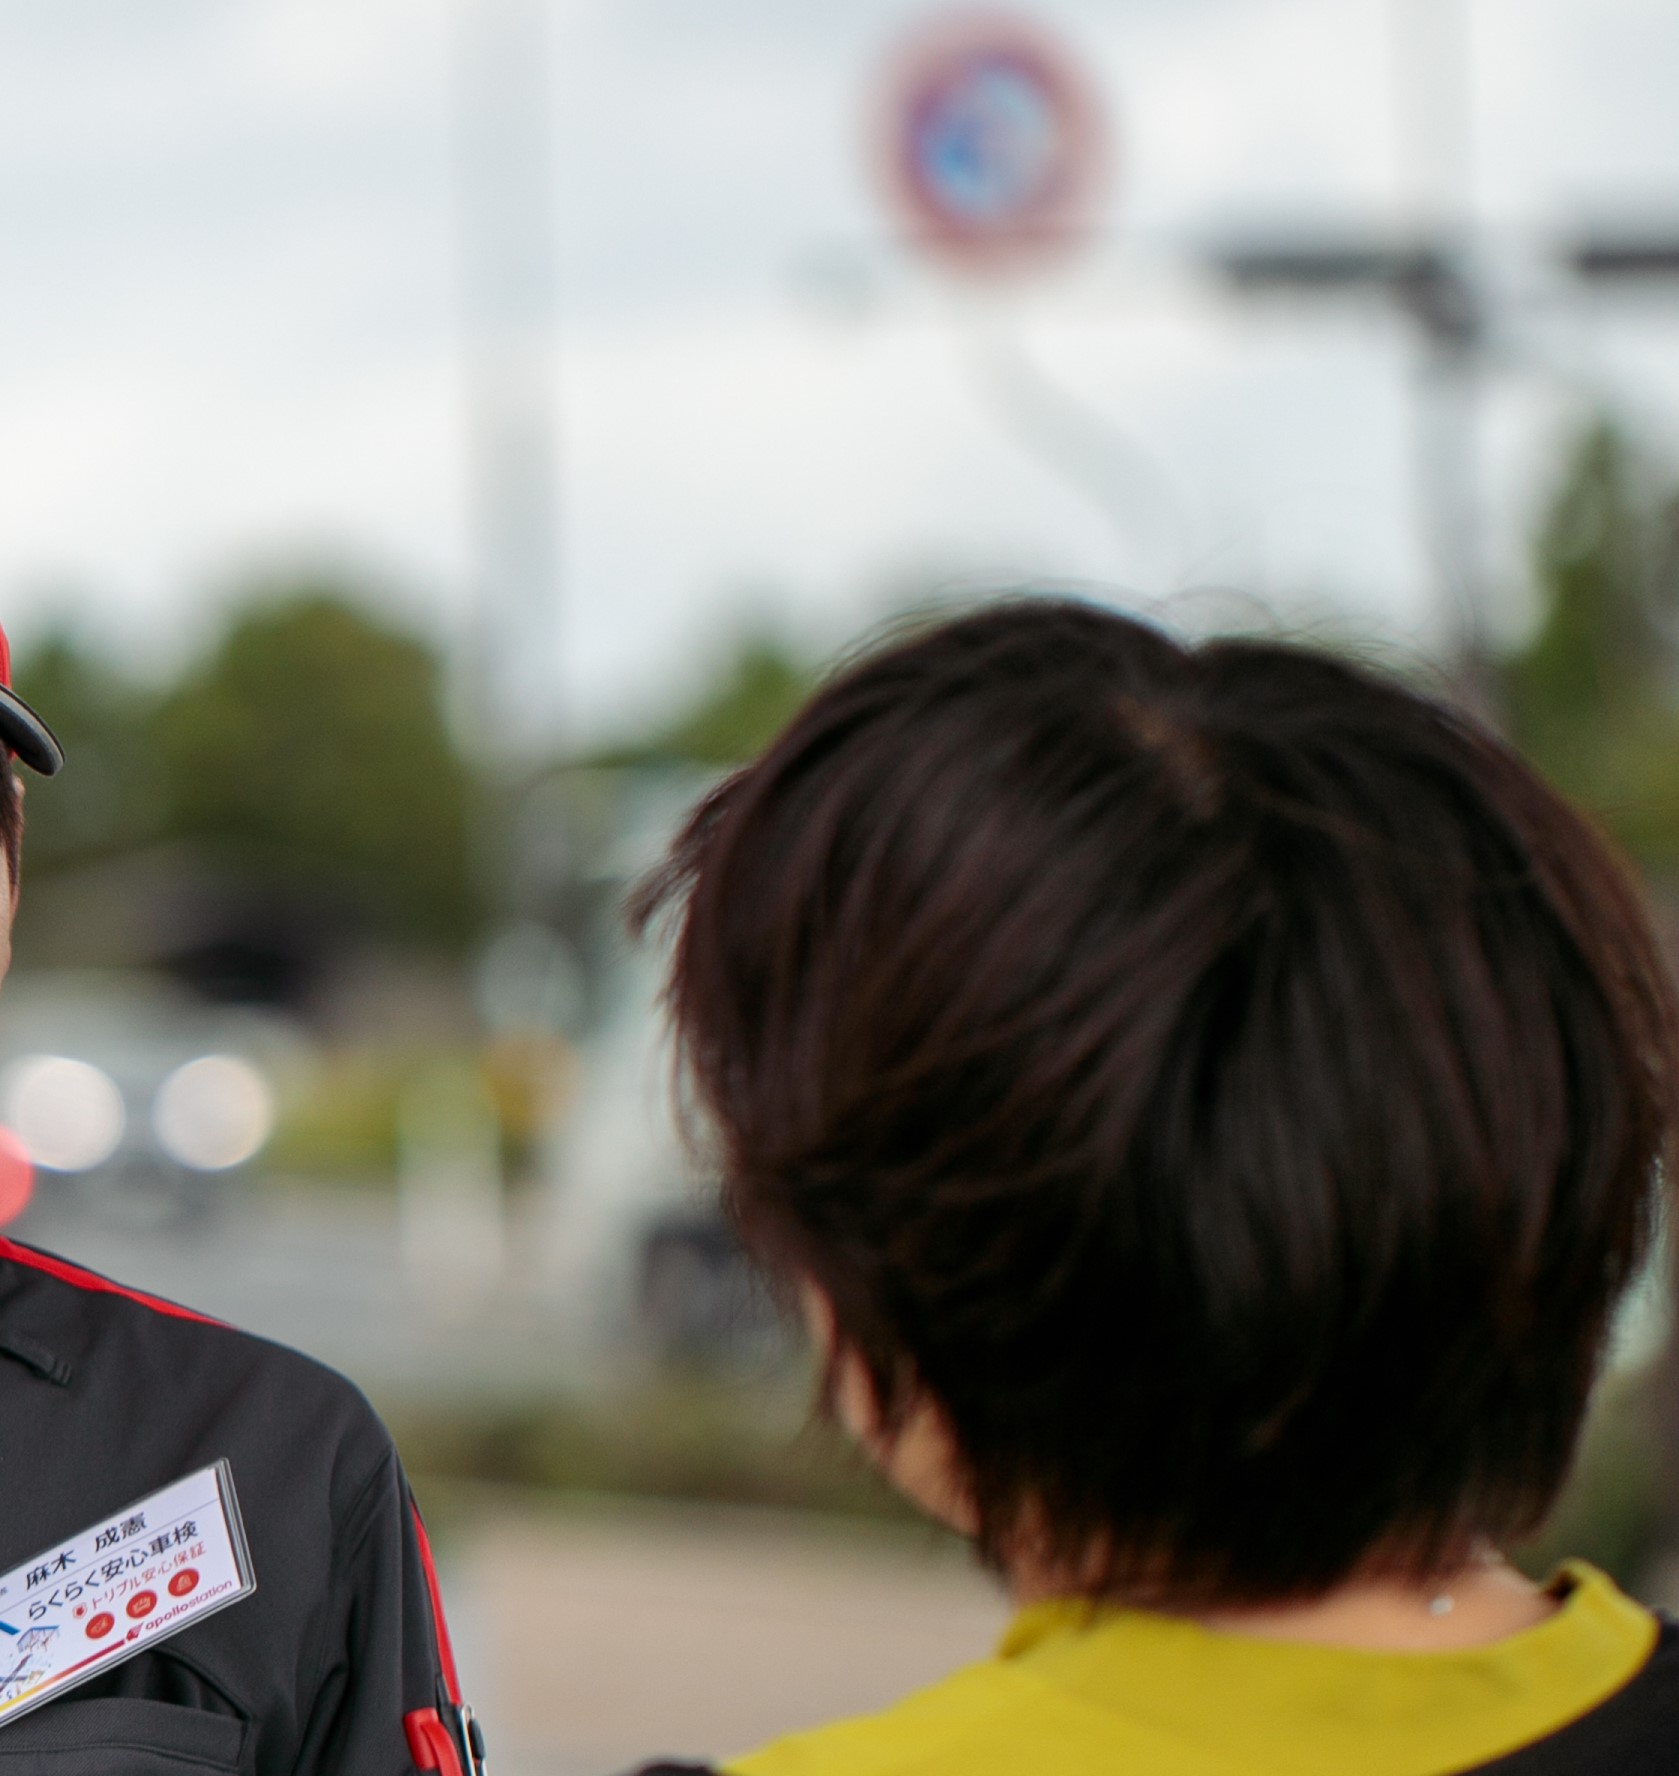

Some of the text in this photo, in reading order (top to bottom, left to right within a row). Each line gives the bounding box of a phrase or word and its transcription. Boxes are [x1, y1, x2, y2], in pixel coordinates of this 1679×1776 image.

[26, 1550, 76, 1591] 麻木
[29, 1520, 198, 1621] らくらく安心車検
[92, 1541, 206, 1609] トリプル安心保証
[145, 1580, 233, 1632] apollostation
